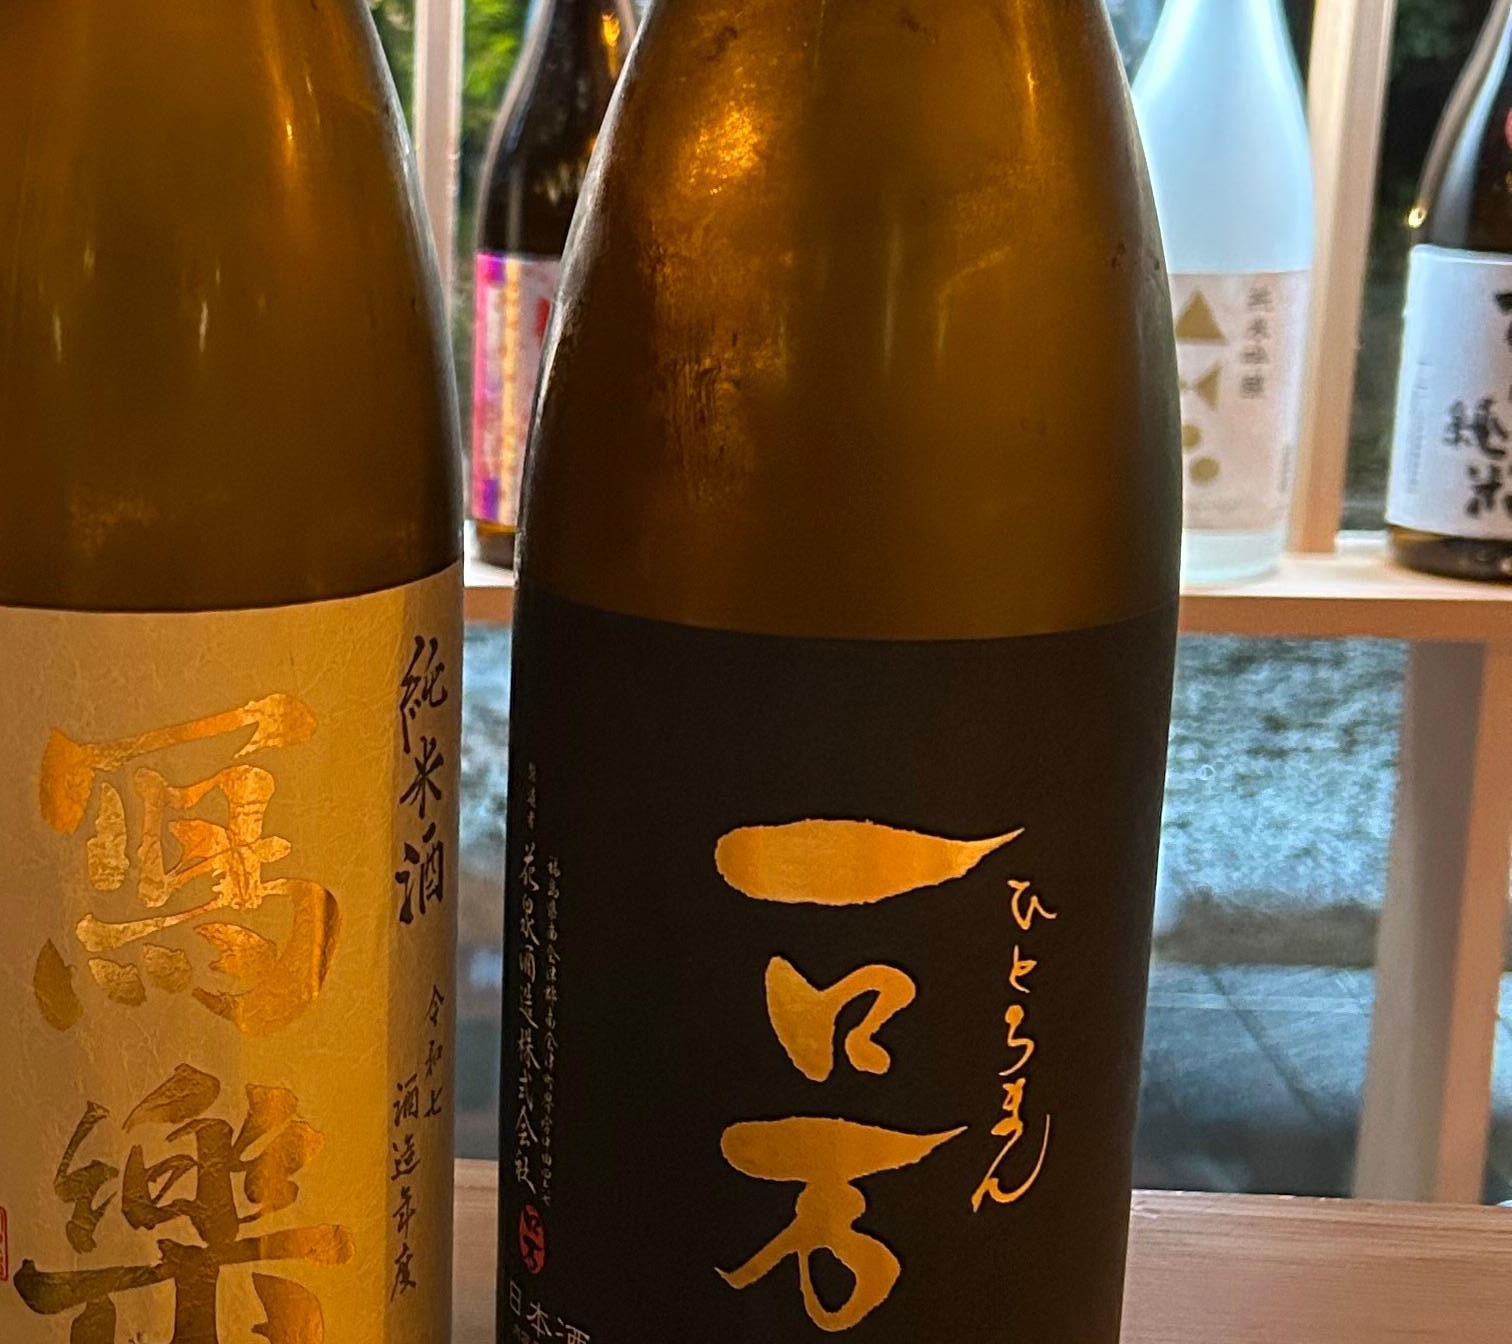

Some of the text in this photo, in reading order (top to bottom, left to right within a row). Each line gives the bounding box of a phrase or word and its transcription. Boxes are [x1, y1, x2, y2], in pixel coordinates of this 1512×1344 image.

[394, 634, 448, 925] 純米酒
[423, 984, 445, 1118] 令和七
[390, 1073, 421, 1303] 酒造年度
